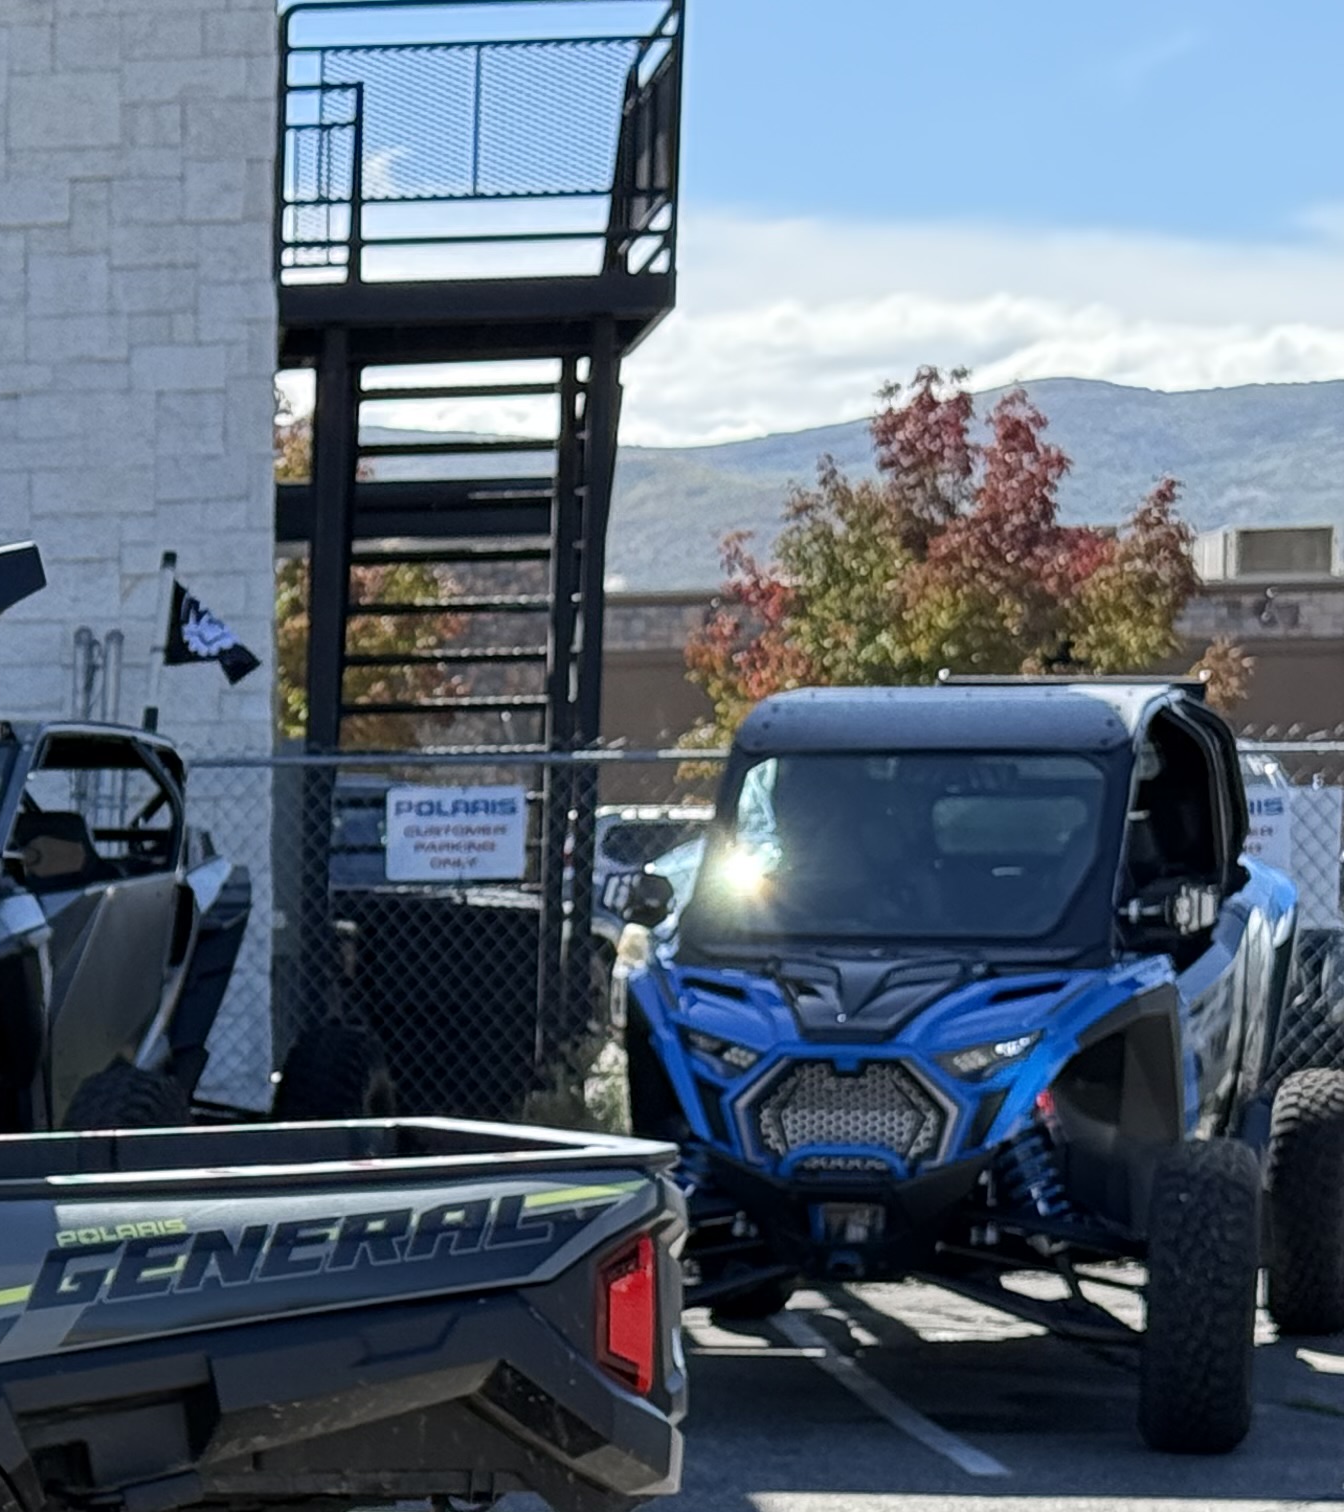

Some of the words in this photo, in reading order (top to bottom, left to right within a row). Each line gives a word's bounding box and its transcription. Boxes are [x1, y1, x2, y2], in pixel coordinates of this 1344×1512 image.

[394, 799, 518, 817] POLARIS
[403, 824, 508, 838] CUSTOMER
[413, 840, 496, 853] PARKING
[429, 857, 477, 870] ONLY
[56, 1217, 187, 1249] POLARIS
[26, 1195, 554, 1306] GENERAL
